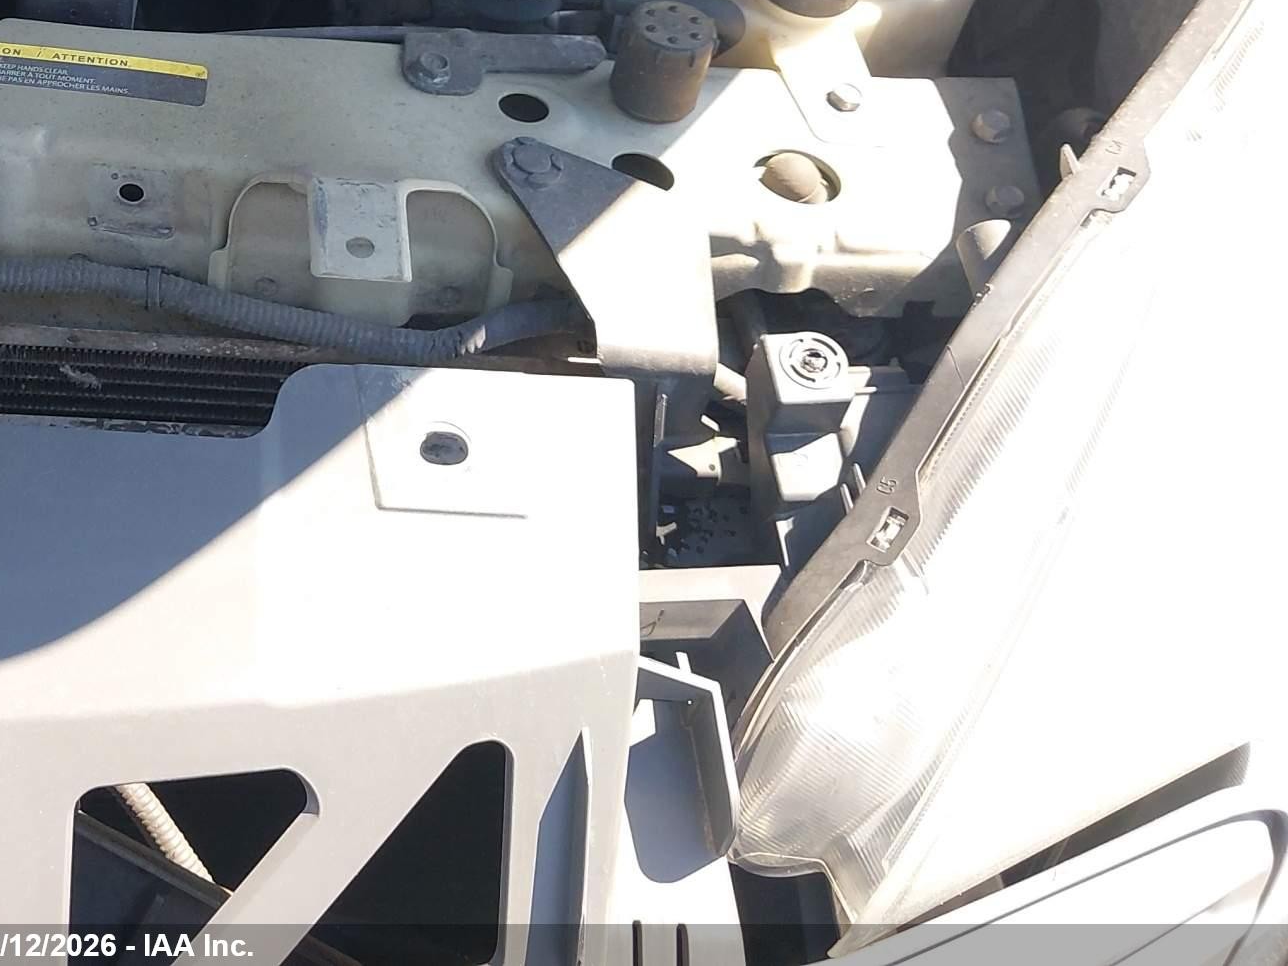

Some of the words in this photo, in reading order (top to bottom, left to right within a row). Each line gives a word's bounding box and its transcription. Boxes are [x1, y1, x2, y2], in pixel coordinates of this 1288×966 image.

[52, 52, 128, 66] ATTENTION
[17, 65, 43, 73] HANDS
[34, 73, 57, 81] TOUT
[8, 76, 23, 84] PAS
[37, 79, 85, 90] APPROCHER
